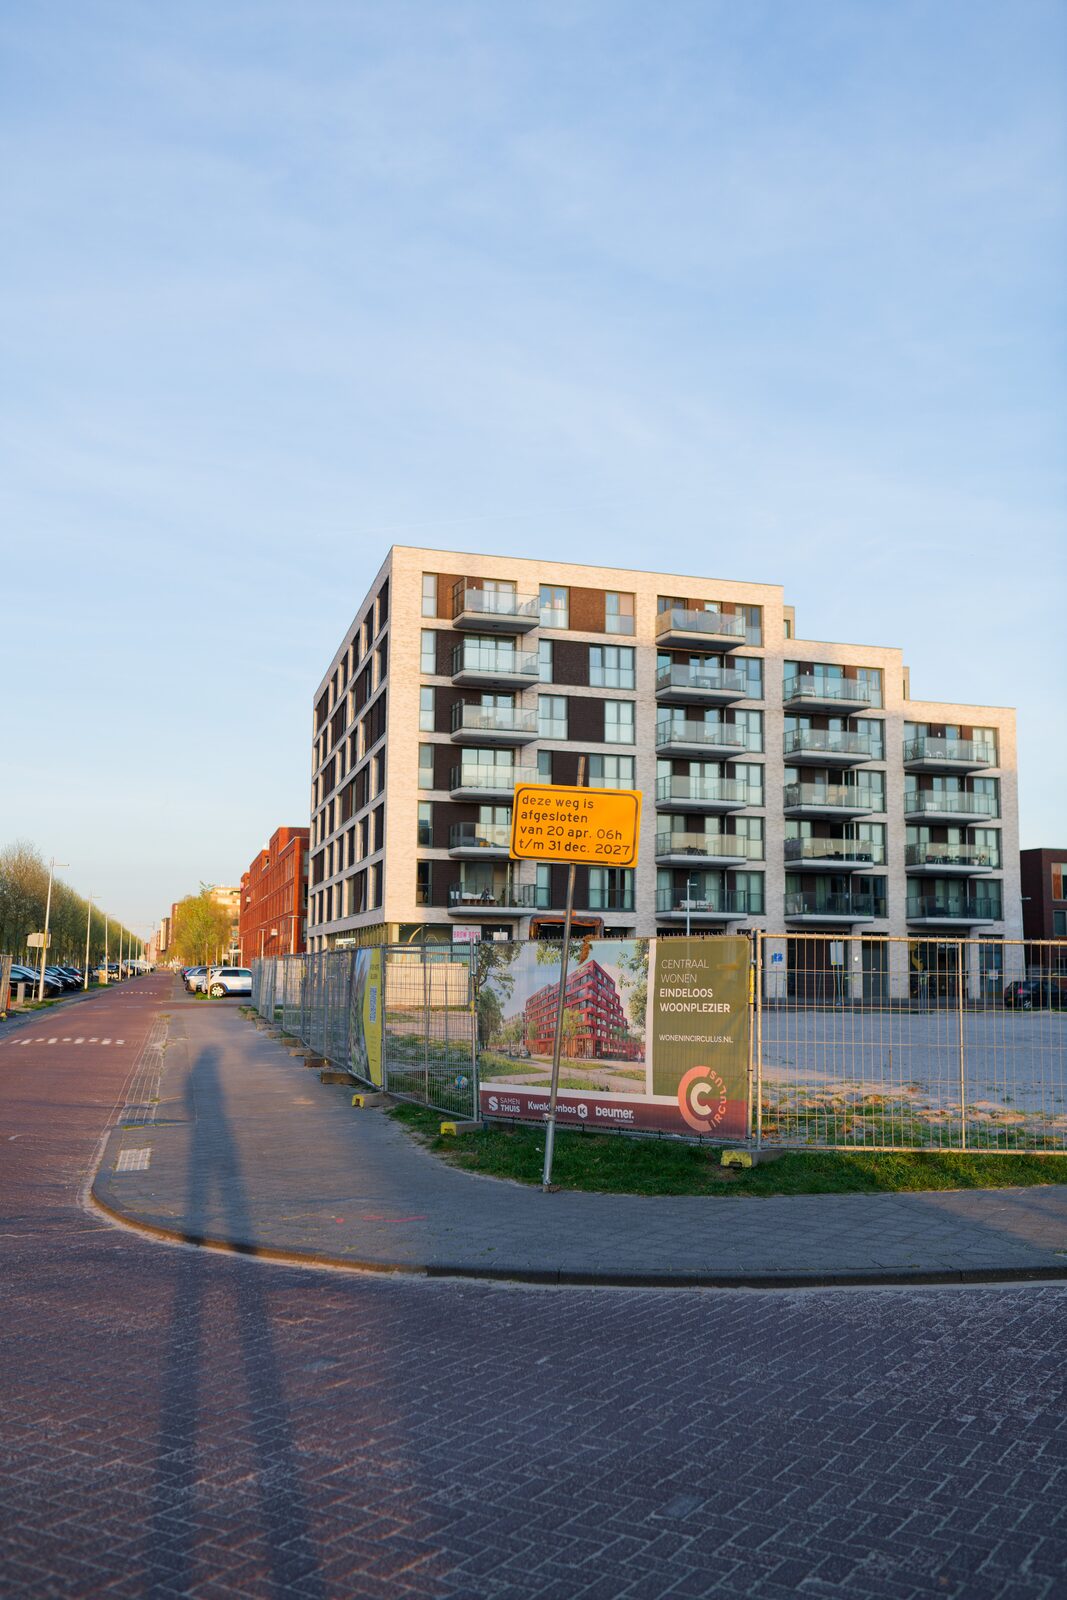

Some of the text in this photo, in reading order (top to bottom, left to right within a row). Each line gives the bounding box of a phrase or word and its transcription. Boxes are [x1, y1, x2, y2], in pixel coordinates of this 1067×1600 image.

[522, 795, 594, 811] deze weg is
[521, 810, 588, 823] afgesloten
[520, 825, 622, 840] van 20 apr. 06h
[519, 839, 630, 855] t/m 31 dec. 2027
[661, 959, 709, 969] CENTRAAL
[661, 974, 697, 984] WONEN
[659, 988, 713, 998] EINDELOOS
[660, 1002, 731, 1013] WOONPLEZIER
[658, 1034, 733, 1044] WONENINCIRCULUS.NL
[500, 1097, 520, 1105] SAMEN
[501, 1105, 520, 1113] THUIS
